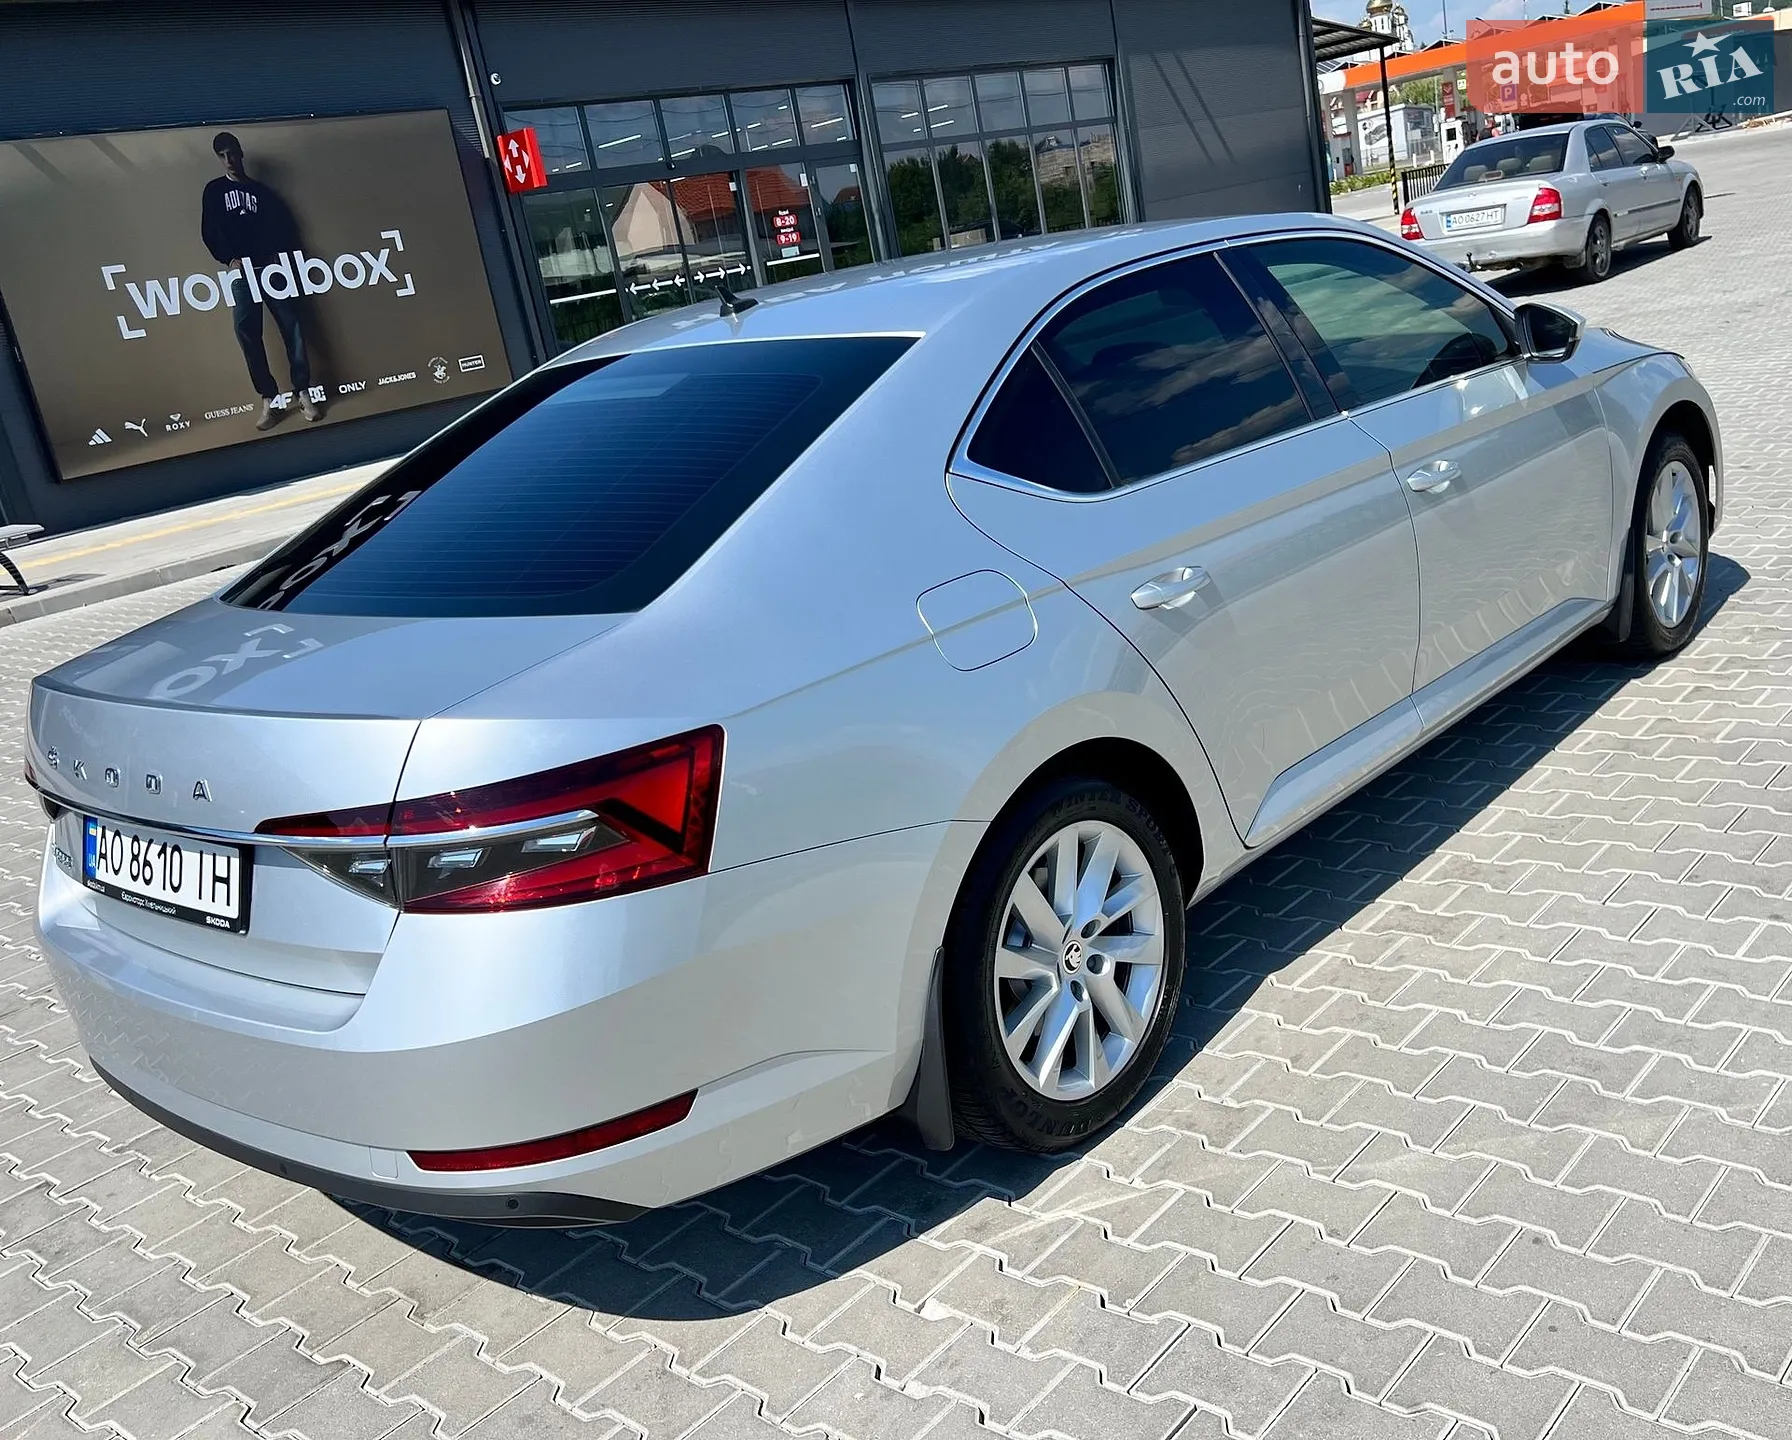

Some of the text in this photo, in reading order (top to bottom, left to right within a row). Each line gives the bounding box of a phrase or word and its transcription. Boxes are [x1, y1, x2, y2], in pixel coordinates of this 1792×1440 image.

[125, 248, 398, 319] worldbox
[338, 380, 367, 394] ONLY
[269, 391, 293, 410] 4F
[204, 403, 255, 420] GUESS JEANS
[165, 420, 191, 432] ROXY
[97, 825, 124, 876] AO
[130, 834, 183, 894] 8610
[198, 850, 231, 907] IH
